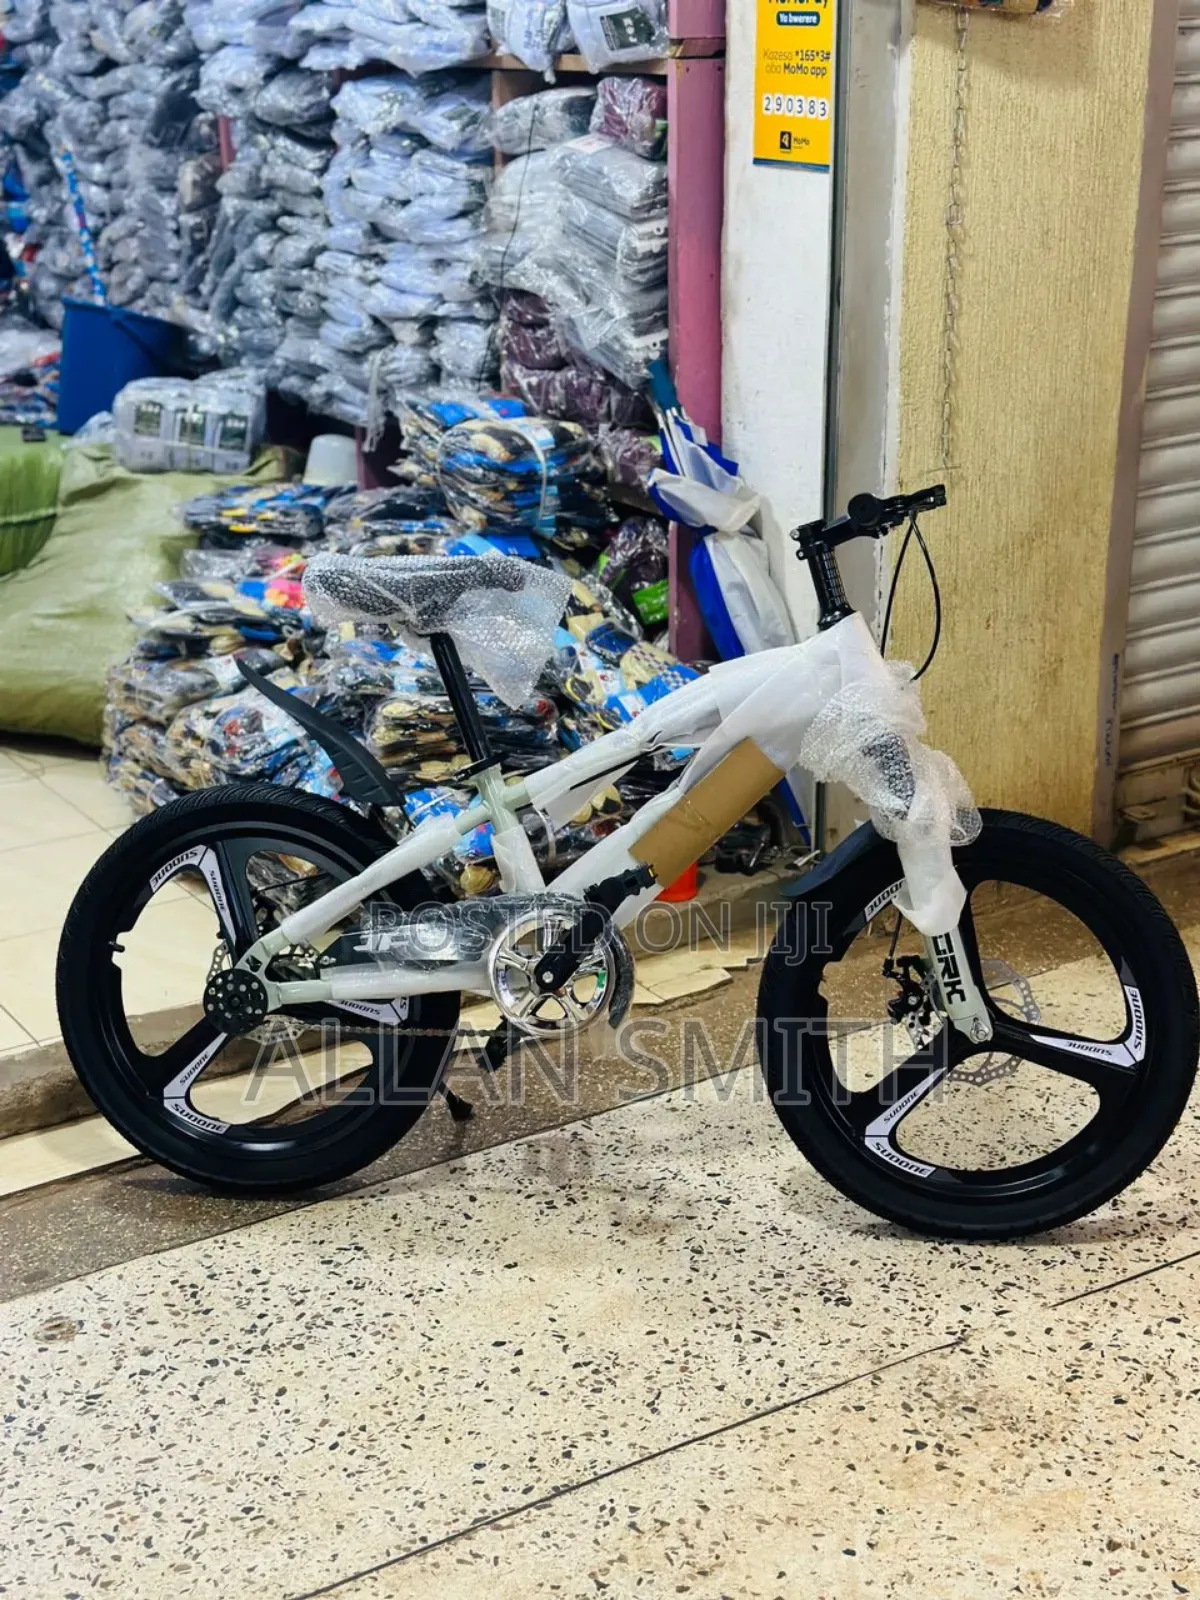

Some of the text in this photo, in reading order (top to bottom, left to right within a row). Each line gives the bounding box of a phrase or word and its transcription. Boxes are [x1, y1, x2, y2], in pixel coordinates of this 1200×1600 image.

[783, 62, 809, 76] MoMo
[810, 66, 827, 80] app
[764, 96, 828, 117] 290383
